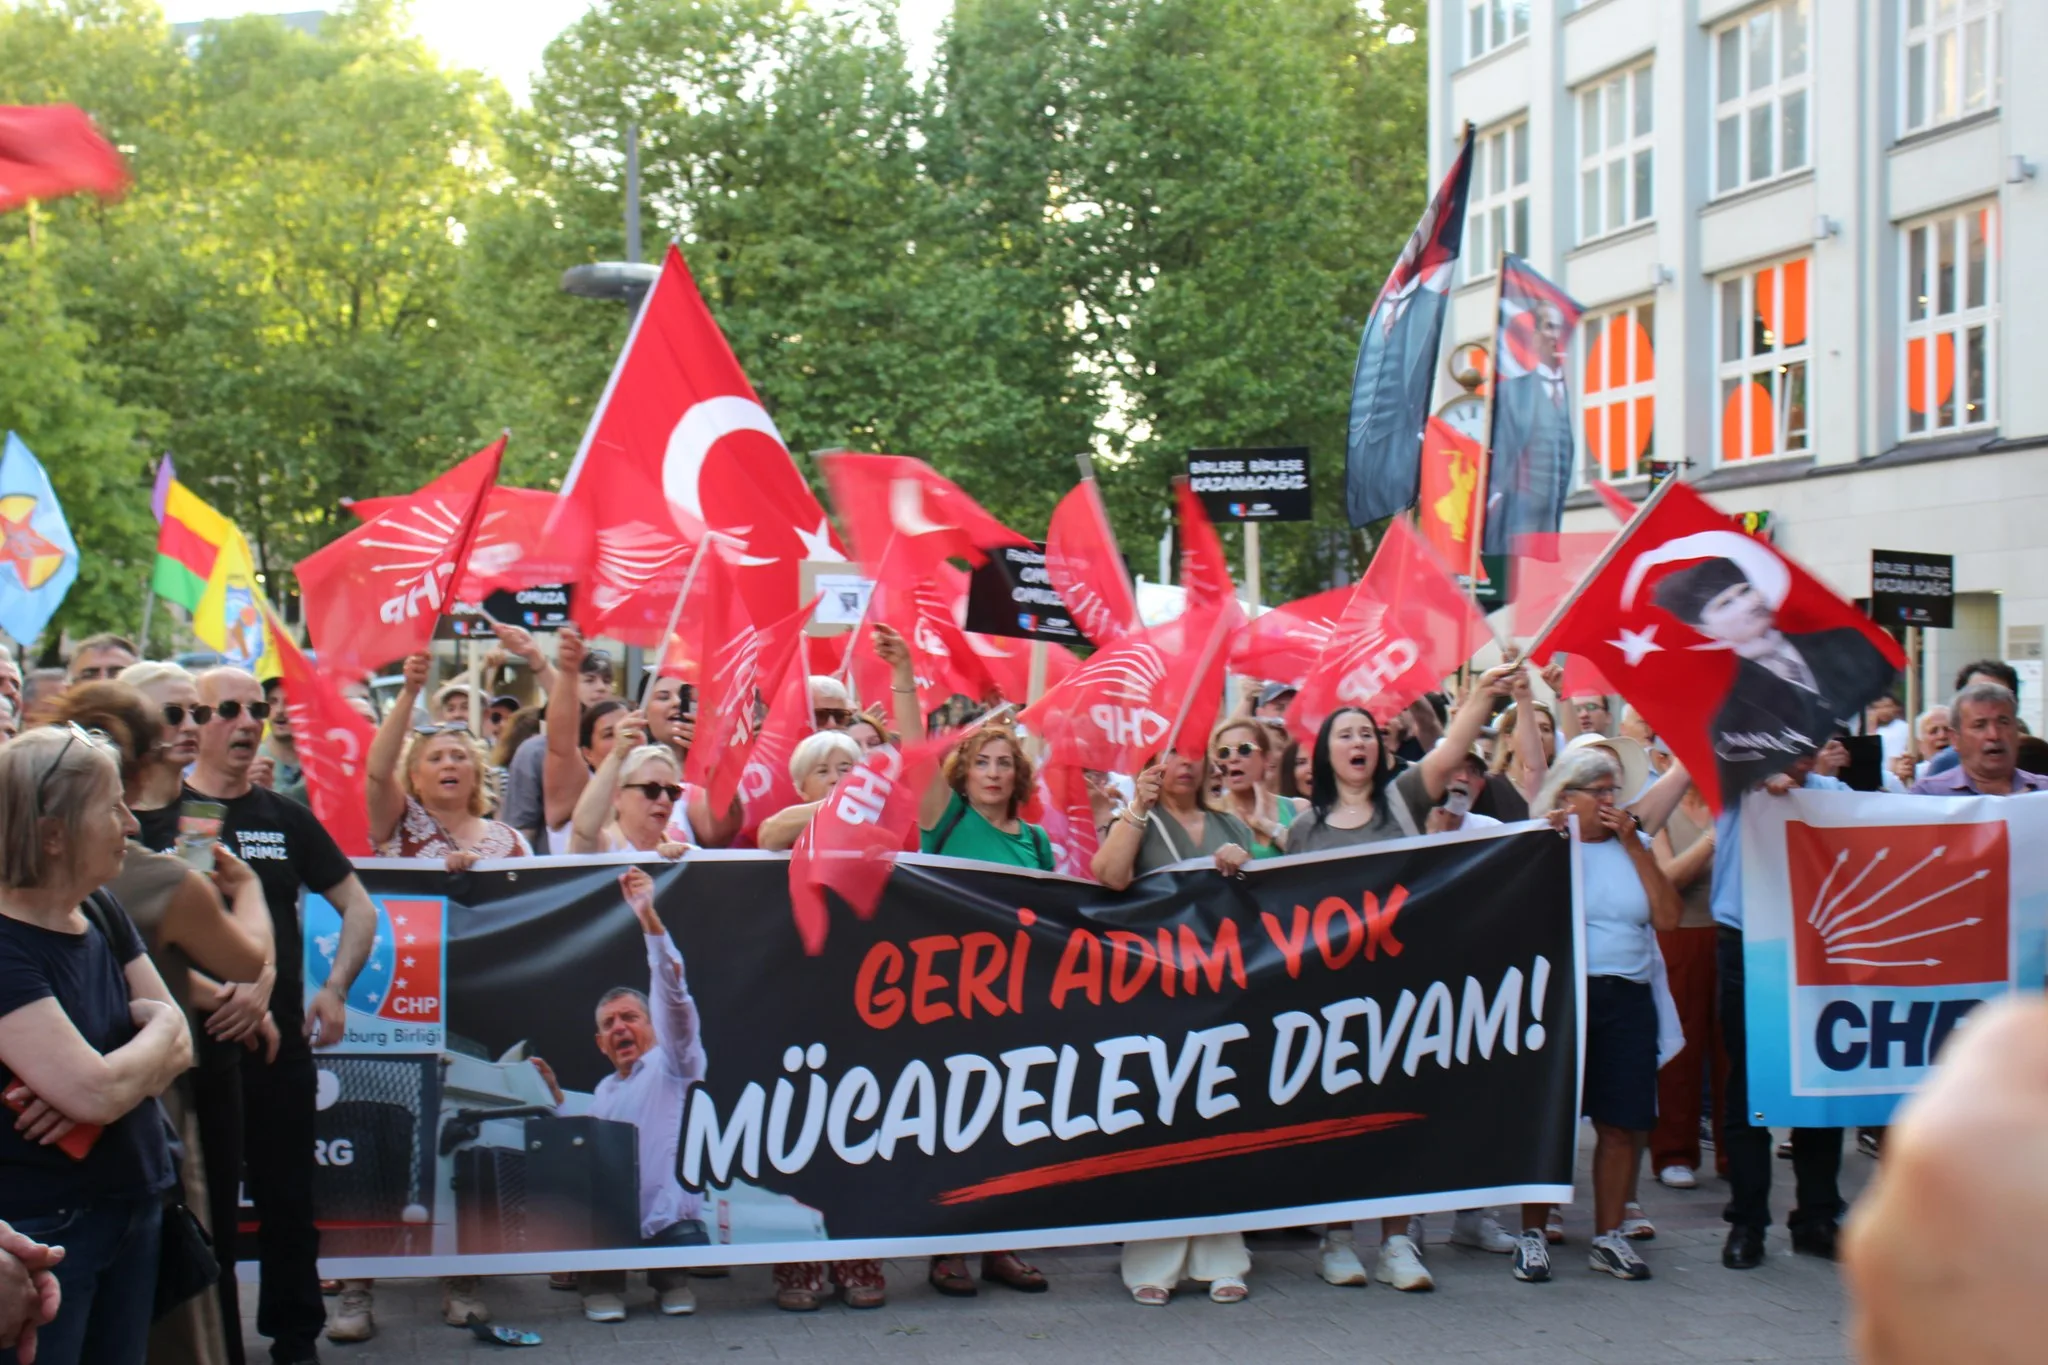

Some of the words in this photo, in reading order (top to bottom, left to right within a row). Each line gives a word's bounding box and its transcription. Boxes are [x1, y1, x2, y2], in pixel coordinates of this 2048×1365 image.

[392, 996, 440, 1014] CHP
[855, 908, 1032, 1030] GERİ
[1050, 917, 1248, 1010] ADIM
[1260, 883, 1410, 980] YOK
[682, 1022, 1250, 1187] MÜCADELEYE
[1268, 955, 1551, 1107] DEVAM!
